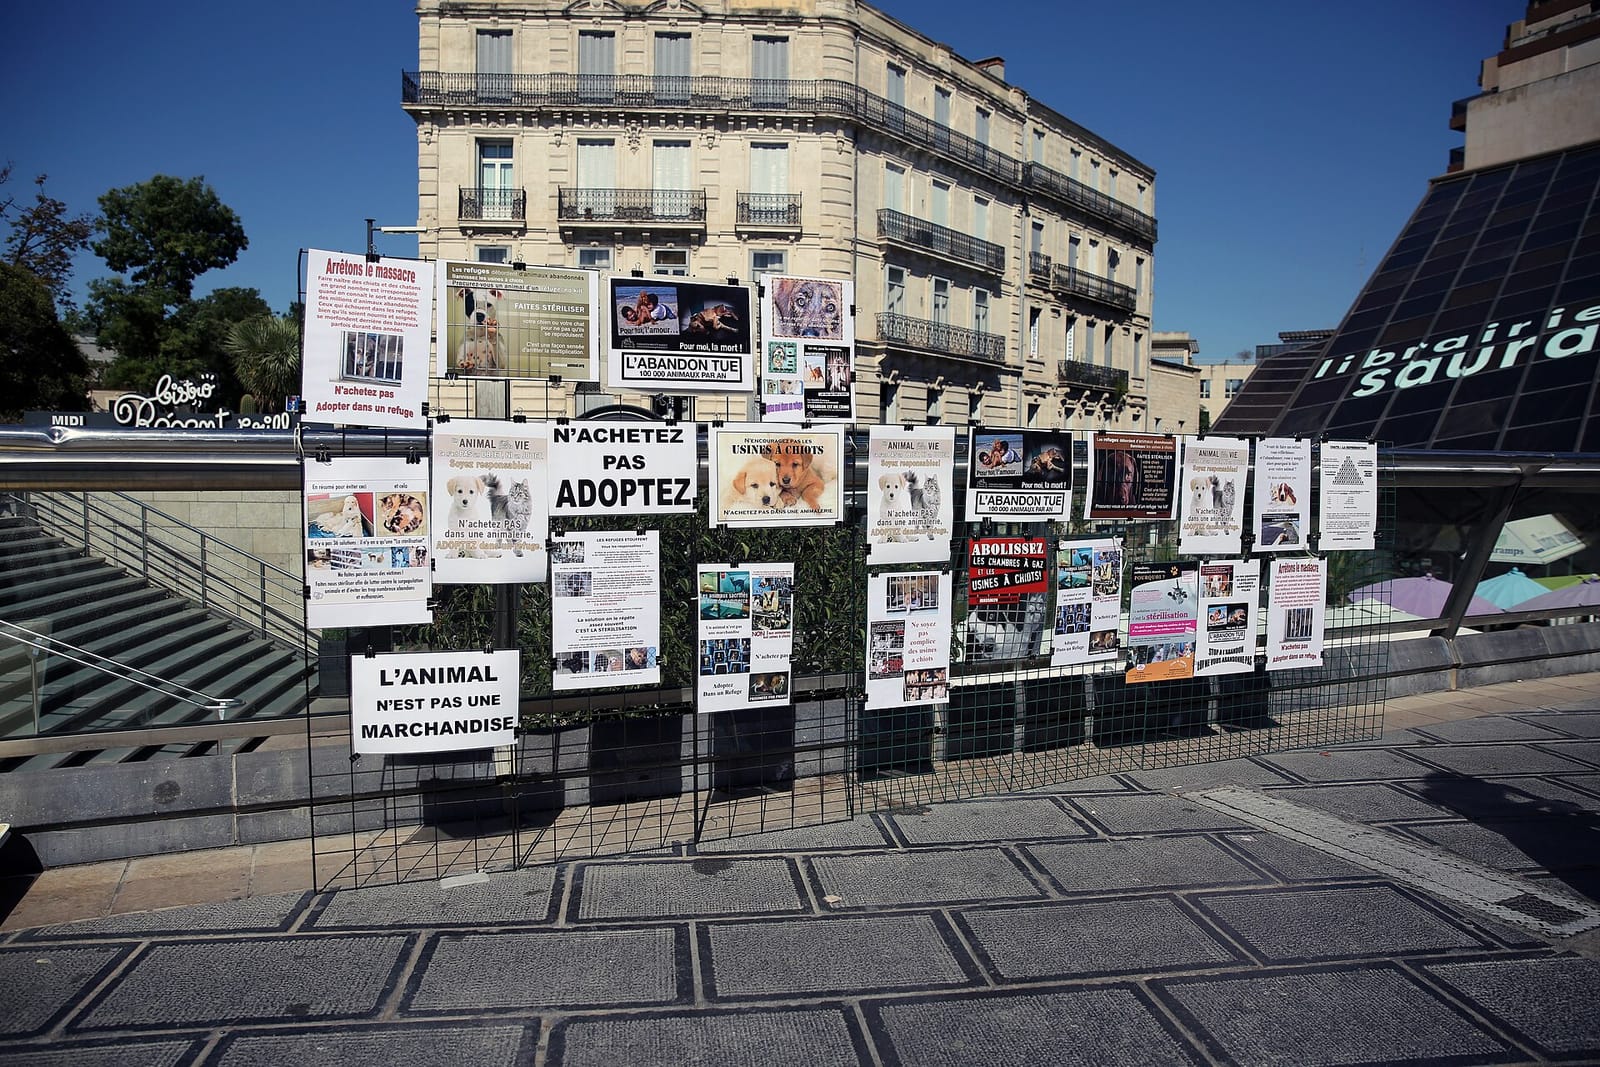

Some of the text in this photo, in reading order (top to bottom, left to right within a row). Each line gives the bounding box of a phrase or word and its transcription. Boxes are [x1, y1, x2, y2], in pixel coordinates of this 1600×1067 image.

[326, 258, 416, 283] Arrêtons le massacre
[464, 267, 490, 275] refuges
[543, 304, 584, 313] STÉRILISER
[680, 342, 742, 352] Pour moi, la mort !
[626, 357, 738, 372] L'ABANDON TUE
[156, 374, 215, 405] bistro
[335, 385, 394, 399] N'achetez pas
[316, 402, 349, 415] Adopter
[352, 402, 372, 412] dans
[388, 406, 413, 418] refuge
[51, 415, 84, 426] MIDI
[554, 428, 683, 443] N'ACHETEZ
[459, 438, 529, 450] ANIMAL VIE
[732, 444, 824, 454] USINES À CHIOTS
[888, 442, 939, 450] ANIMAL VIE
[449, 459, 474, 469] Soyez
[603, 455, 646, 470] PAS
[556, 478, 691, 508] ADOPTEZ
[979, 495, 1062, 506] L'ABANDON TUE
[887, 509, 933, 518] N'achetez PAS
[458, 520, 521, 528] N'achetez PAS
[445, 530, 464, 538] dans
[436, 541, 477, 549] ADOPTEZ
[972, 542, 1043, 555] ABOLISSEZ
[973, 557, 1044, 568] LES CHAMBRES À GAZ
[972, 570, 1042, 590] USINES À CHIOTS!
[1146, 611, 1188, 620] stérilisation
[380, 666, 498, 686] L'ANIMAL
[377, 694, 501, 711] N'EST PAS UNE
[361, 716, 514, 739] MARCHANDISE
